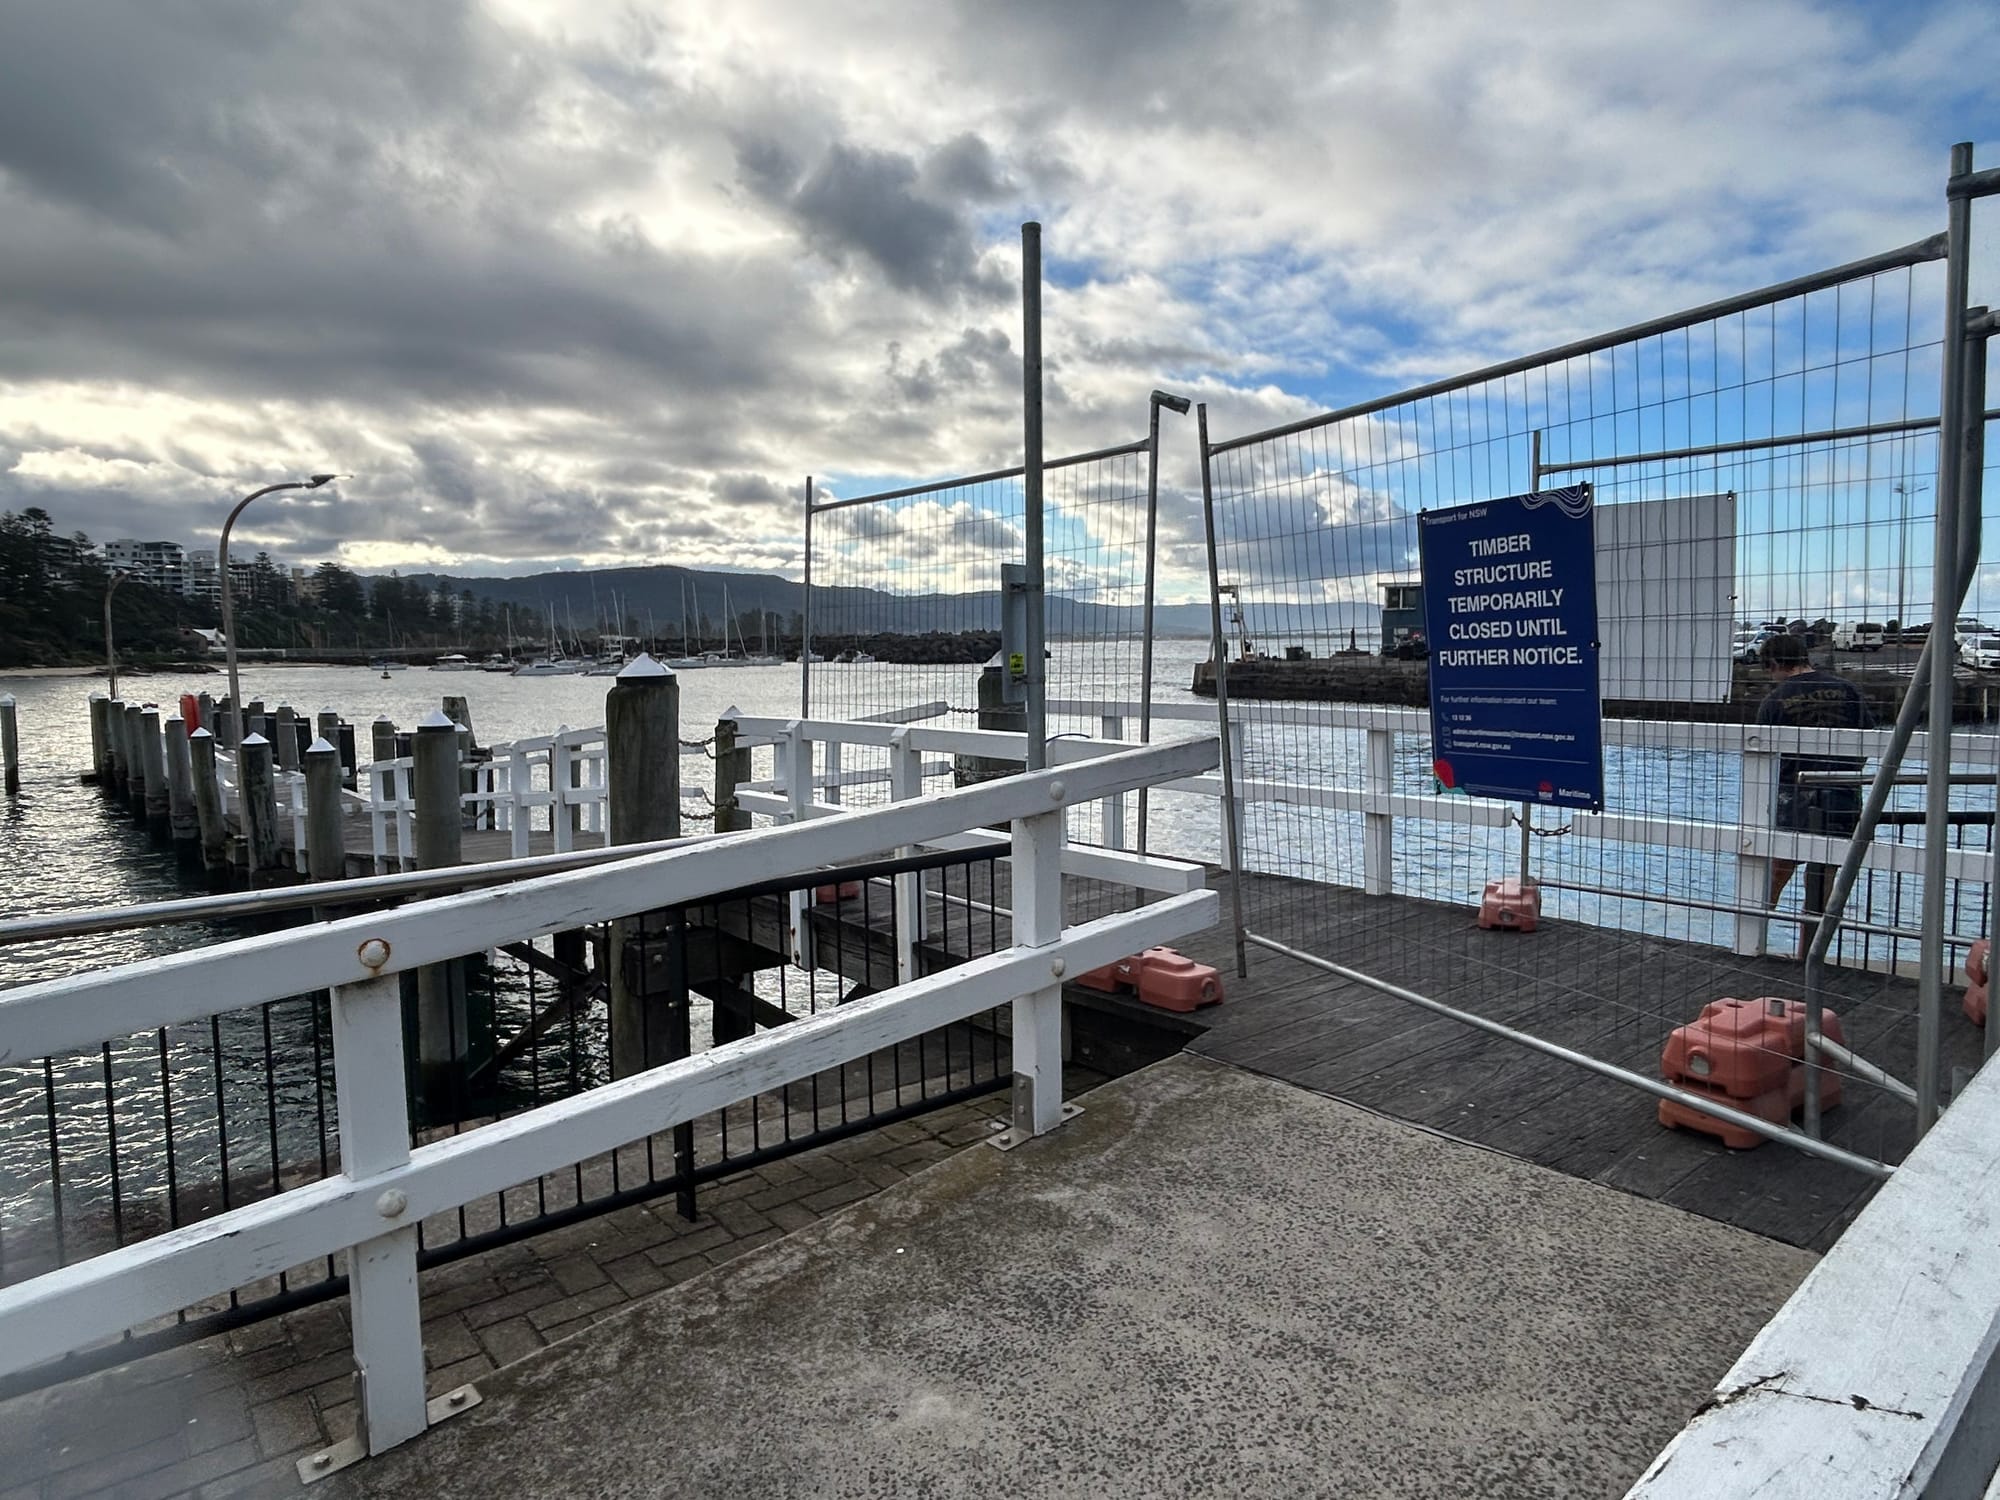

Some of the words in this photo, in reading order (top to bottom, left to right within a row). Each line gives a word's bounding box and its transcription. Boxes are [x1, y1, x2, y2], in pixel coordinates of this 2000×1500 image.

[1457, 512, 1467, 521] for
[1469, 508, 1488, 518] NSW
[1468, 534, 1531, 557] TIMBER
[1454, 560, 1552, 586] STRUCTURE
[1448, 589, 1563, 613] TEMPORARILY
[1449, 621, 1512, 640] CLOSED
[1516, 619, 1567, 637] UNTIL
[1439, 650, 1509, 666] FURTHER
[1513, 647, 1583, 666] NOTICE.
[1440, 695, 1450, 703] For
[1470, 696, 1503, 704] information
[1558, 788, 1591, 800] Maritime
